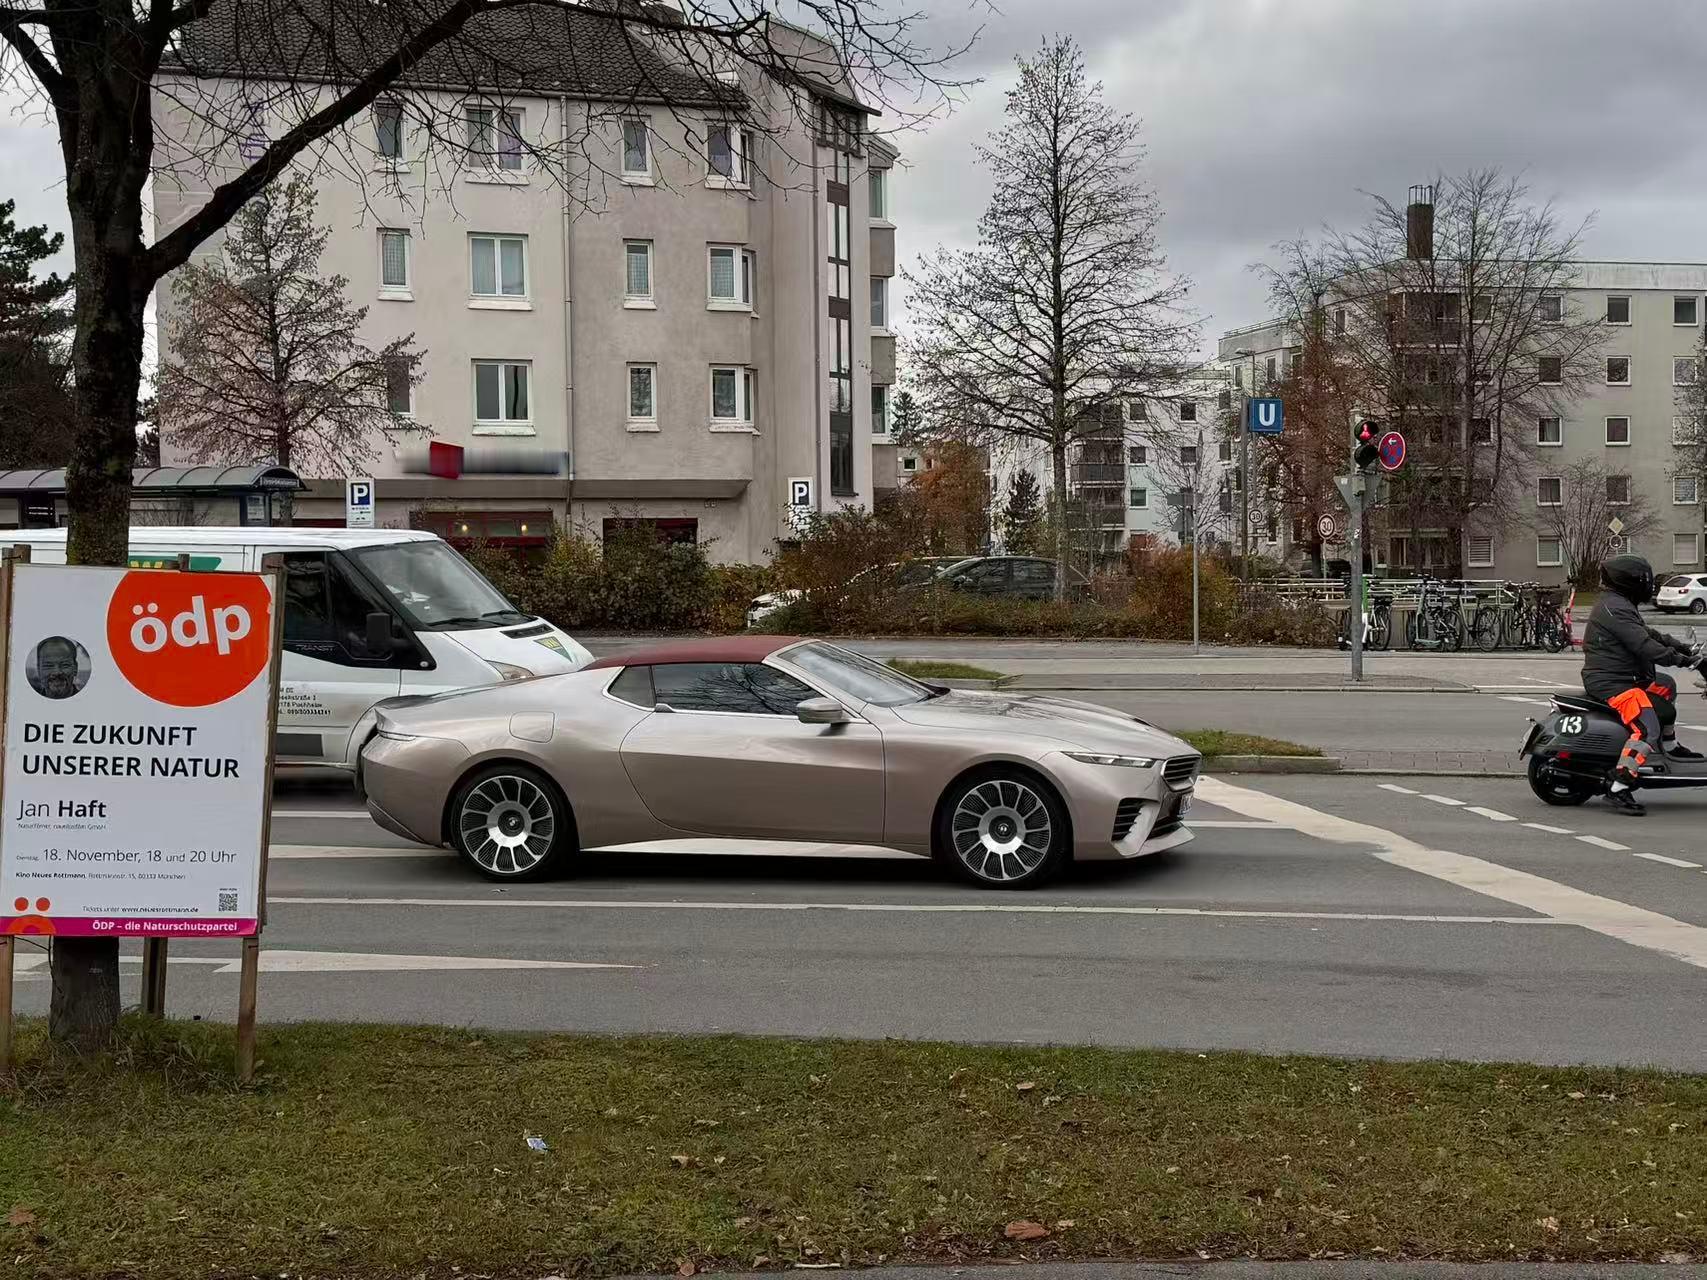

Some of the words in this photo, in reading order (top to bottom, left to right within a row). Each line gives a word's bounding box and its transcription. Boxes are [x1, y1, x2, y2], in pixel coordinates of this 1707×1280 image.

[1259, 403, 1276, 427] U
[353, 484, 369, 504] P
[794, 483, 808, 504] P
[1321, 520, 1332, 533] 30
[130, 595, 251, 656] ödp
[24, 723, 65, 744] DIE
[72, 724, 197, 746] ZUKUNFT
[1560, 716, 1582, 734] 13
[22, 755, 142, 777] UNSERER
[151, 757, 240, 778] NATUR
[16, 800, 50, 821] Jan
[58, 800, 107, 818] Haft
[43, 848, 62, 861] 18.
[67, 849, 141, 864] November,
[147, 850, 162, 862] 18
[166, 853, 185, 863] und
[190, 850, 206, 863] 20
[211, 850, 237, 863] Uhr
[92, 920, 115, 931] ÖDP
[125, 921, 141, 931] die
[143, 922, 238, 933] Naturschutzpartei
